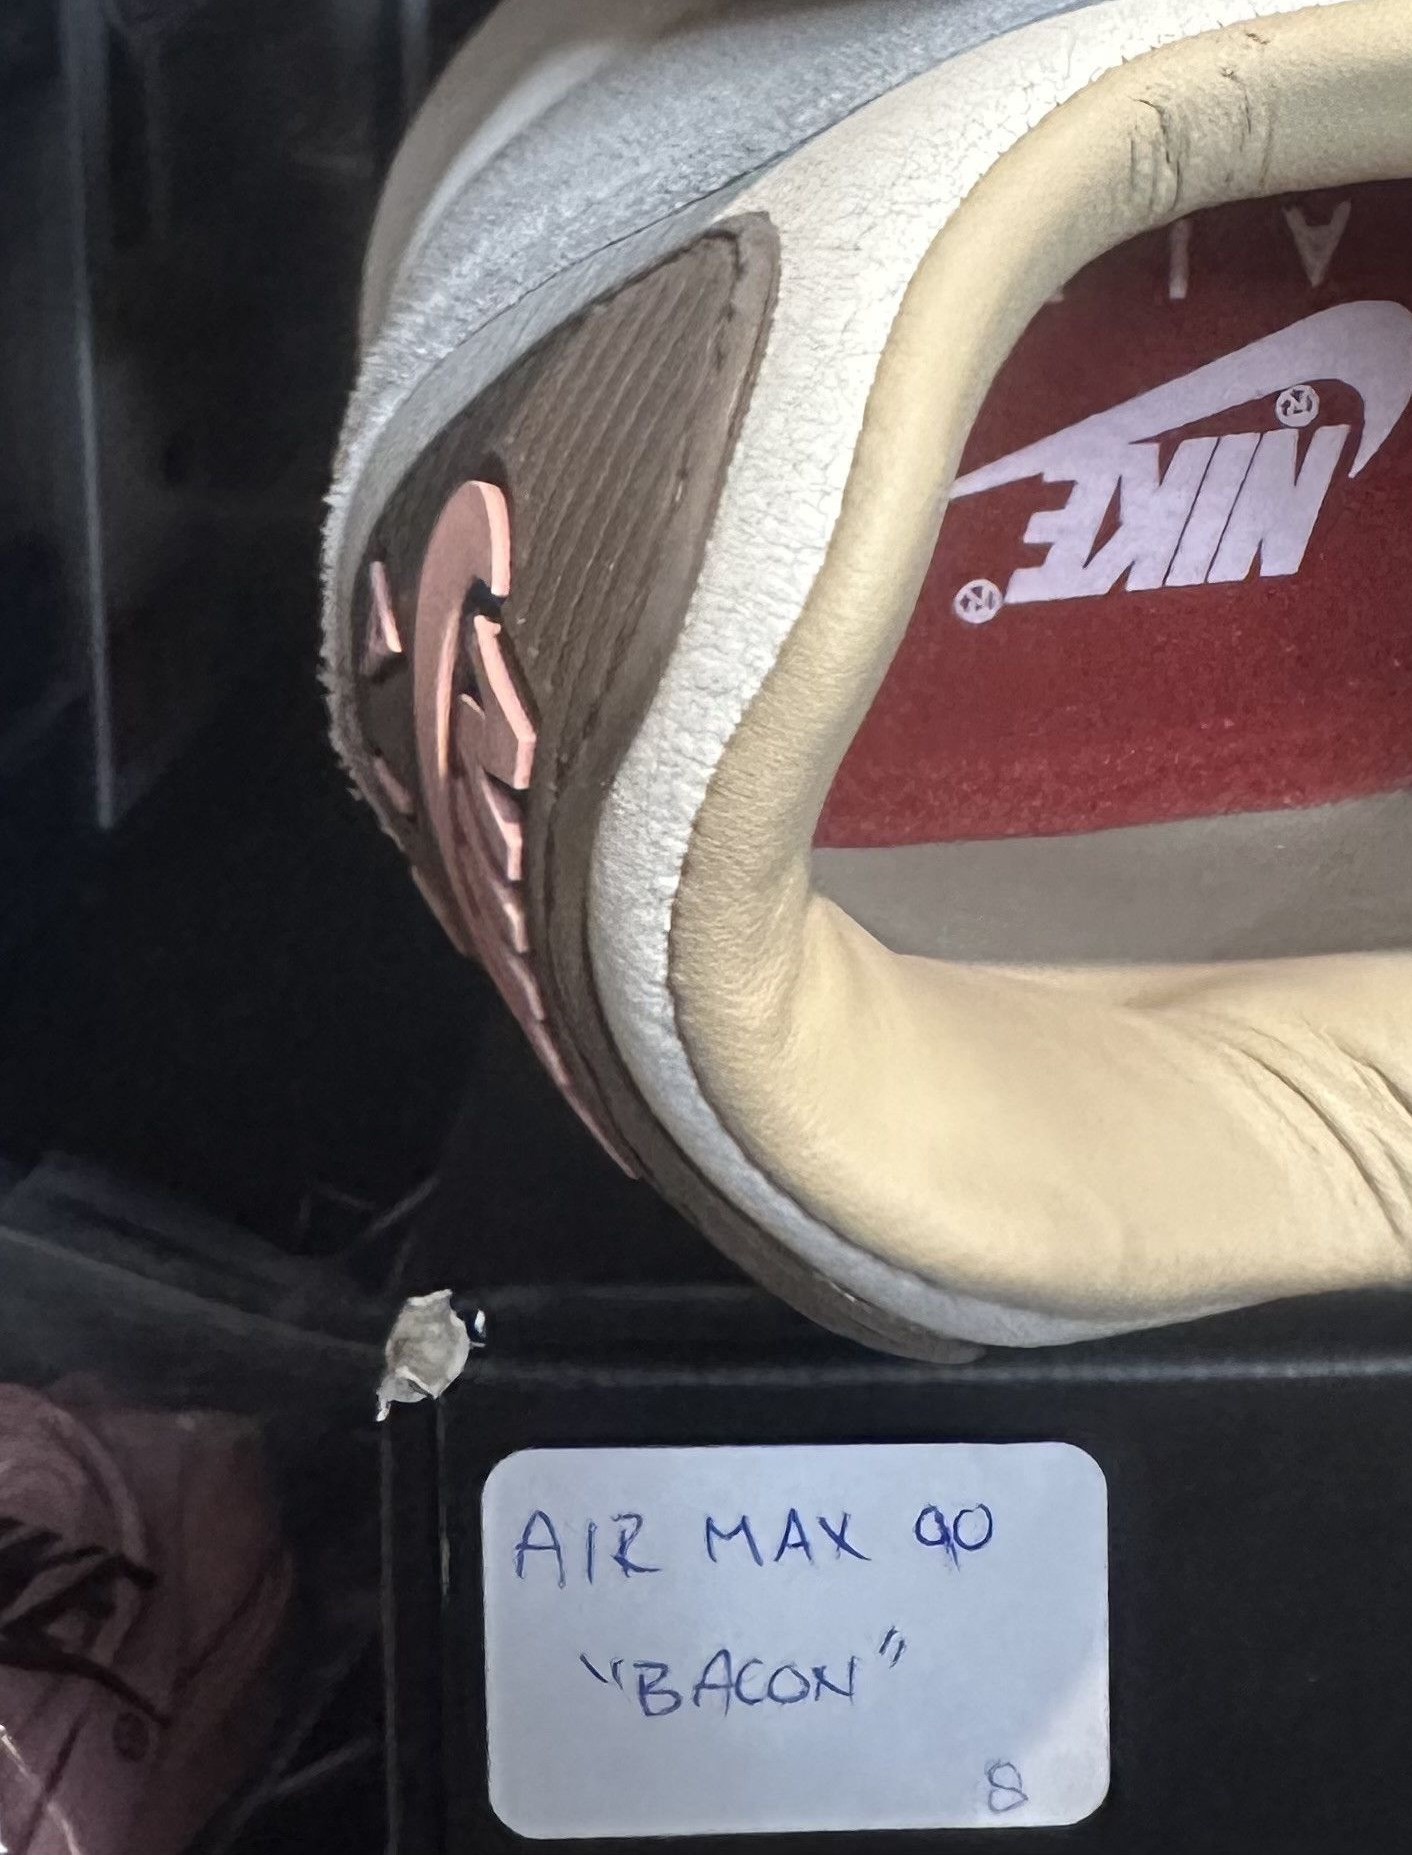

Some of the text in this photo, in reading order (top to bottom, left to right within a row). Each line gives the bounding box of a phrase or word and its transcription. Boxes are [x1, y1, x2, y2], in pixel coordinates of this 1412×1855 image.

[514, 1502, 994, 1588] AIR MAX 90
[984, 1759, 1029, 1814] 8
